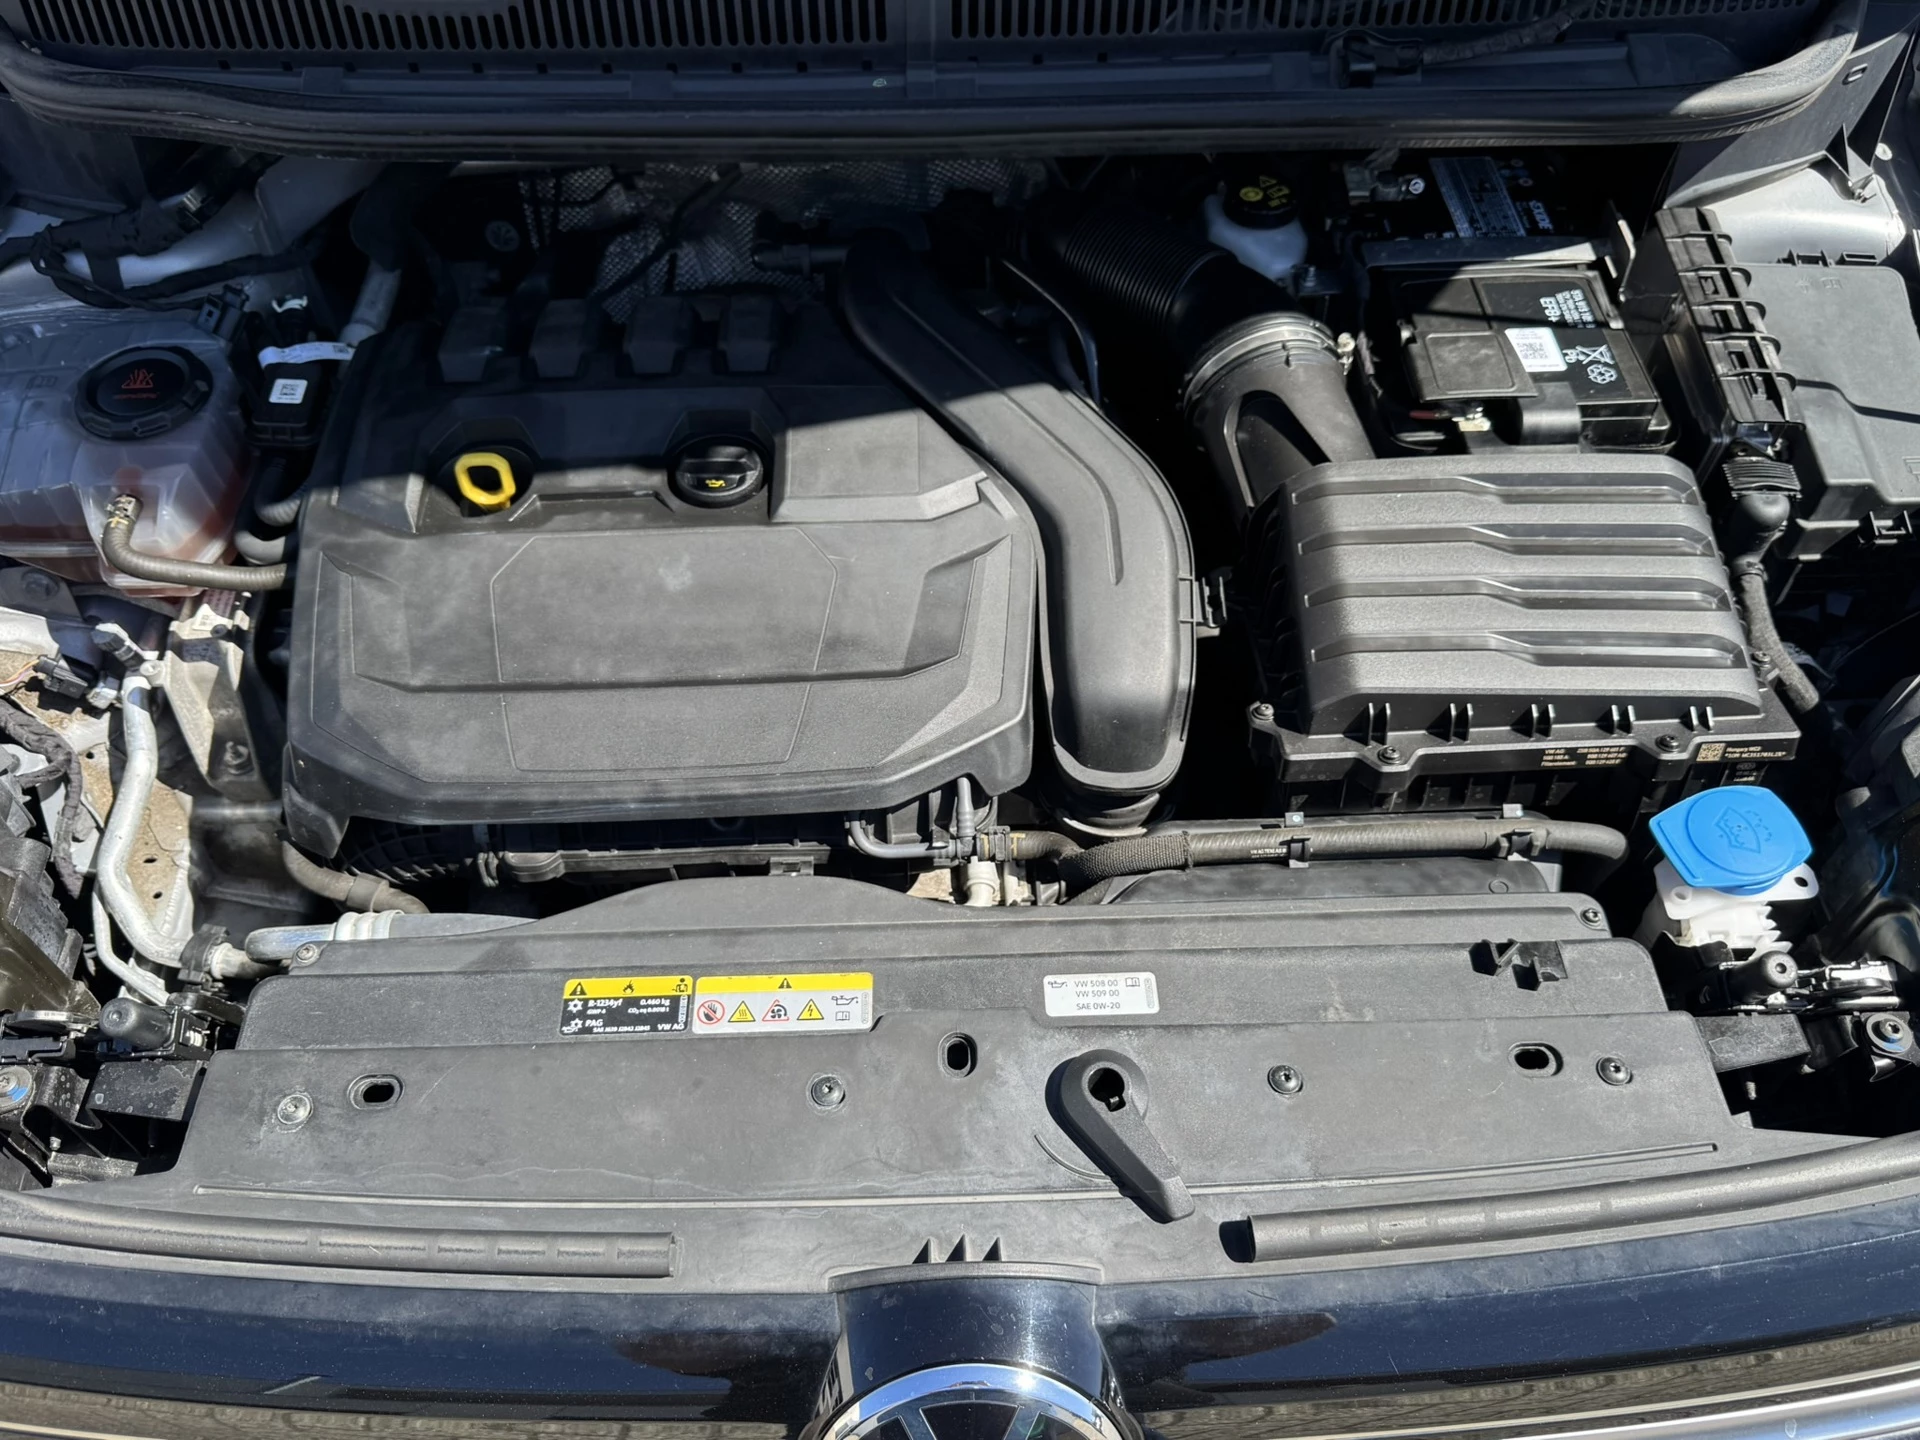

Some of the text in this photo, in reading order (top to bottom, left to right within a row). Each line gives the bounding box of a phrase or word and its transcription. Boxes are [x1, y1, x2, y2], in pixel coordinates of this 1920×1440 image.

[1562, 349, 1577, 363] Pb
[1074, 980, 1088, 988] VW
[1107, 979, 1118, 987] 00
[1075, 990, 1089, 998] VW
[1109, 989, 1119, 997] 00
[588, 998, 623, 1008] R-1234yf
[661, 998, 670, 1006] kg
[1093, 1002, 1120, 1010] 0W-20
[585, 1019, 604, 1027] PAG
